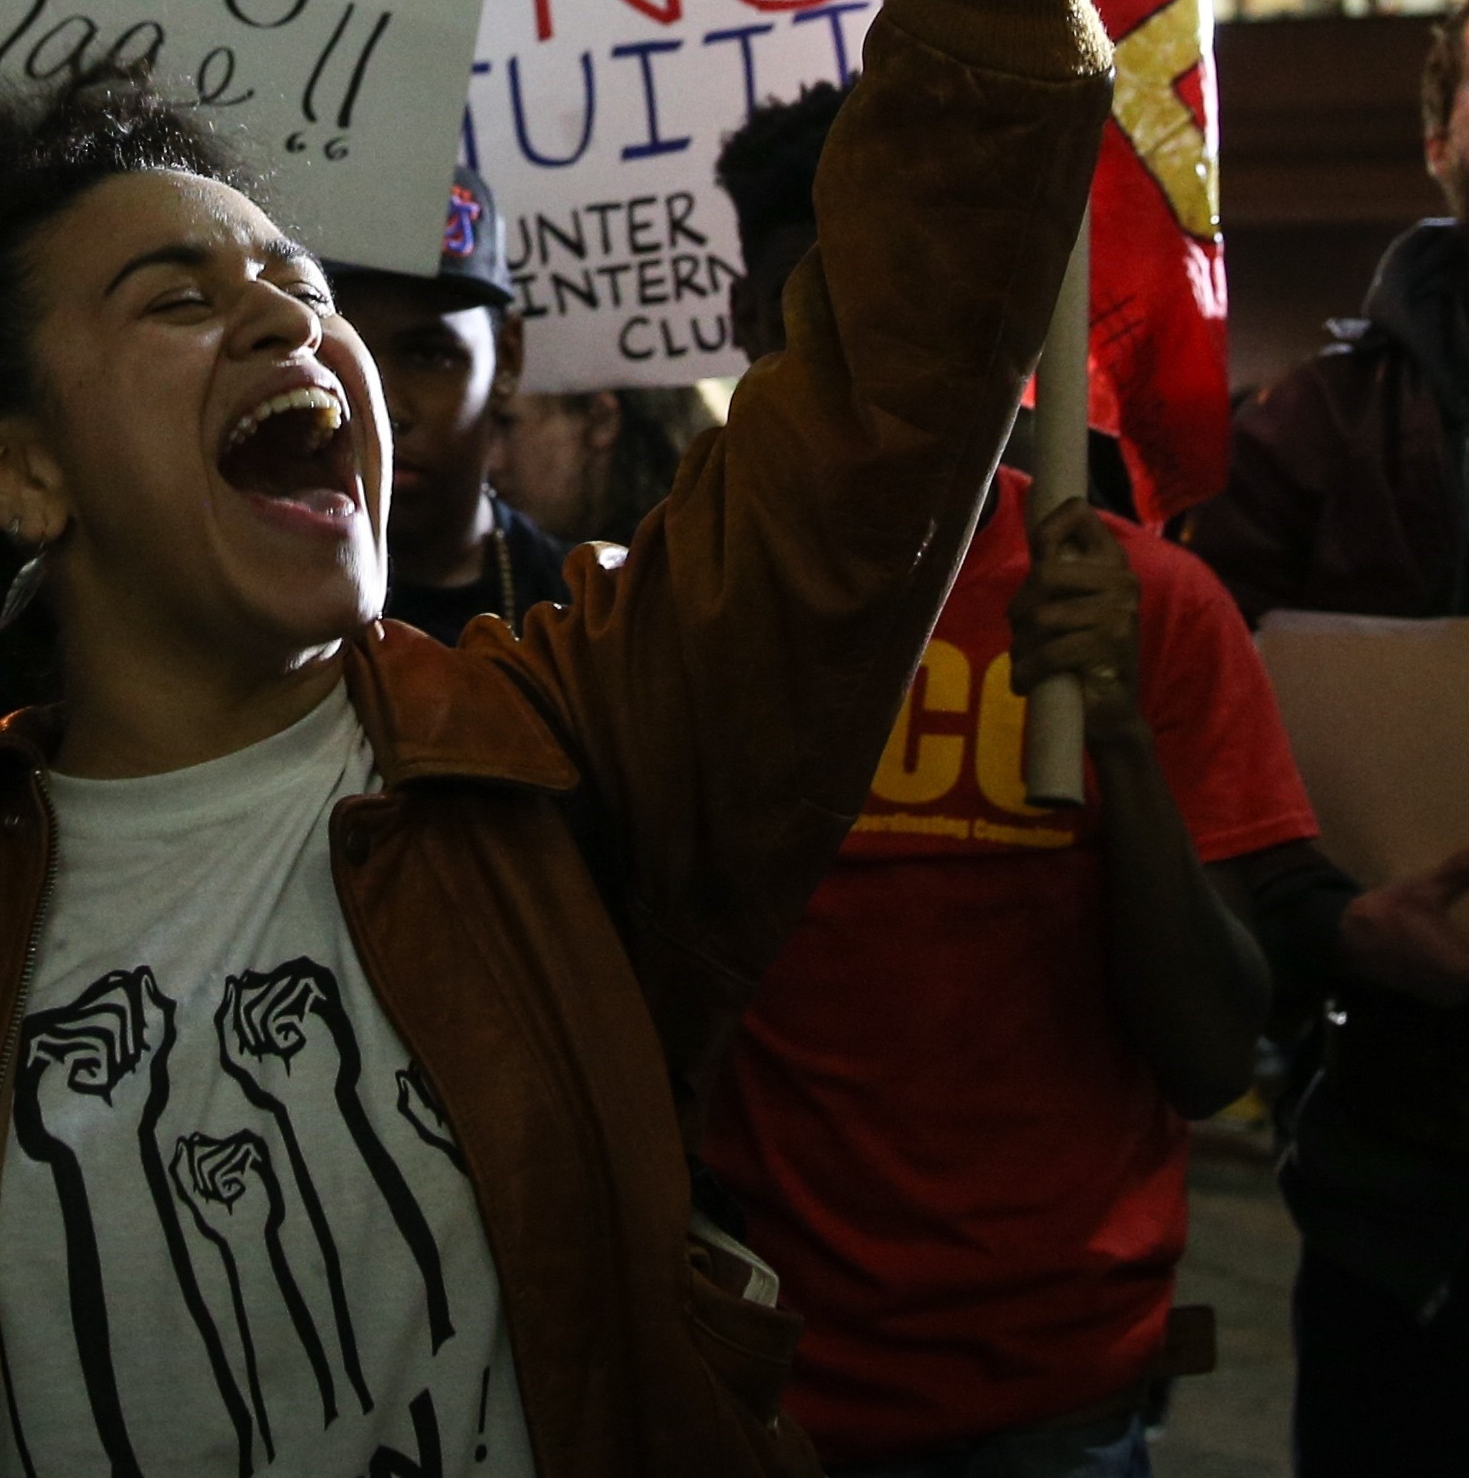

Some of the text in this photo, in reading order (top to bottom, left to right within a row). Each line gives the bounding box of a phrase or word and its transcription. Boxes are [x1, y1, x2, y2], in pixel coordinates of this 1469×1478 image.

[507, 191, 708, 270] UNTER
[509, 253, 745, 321] INTERN
[617, 315, 728, 362] CLU
